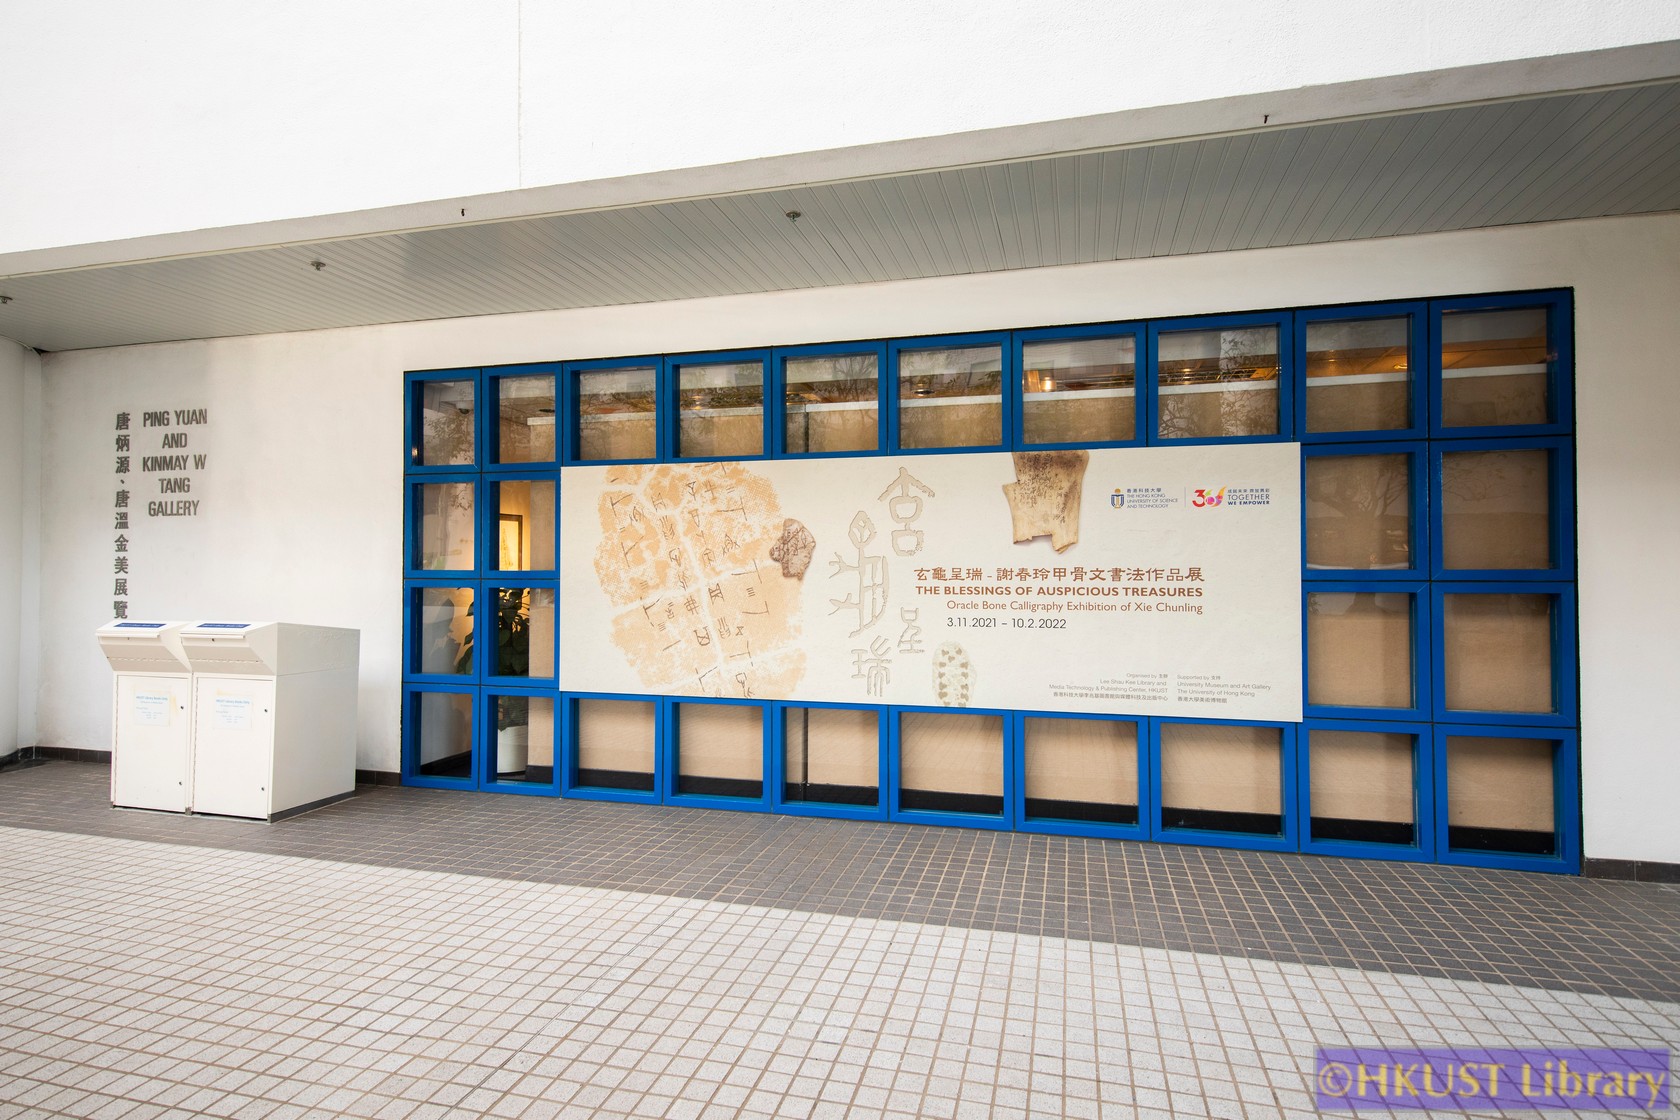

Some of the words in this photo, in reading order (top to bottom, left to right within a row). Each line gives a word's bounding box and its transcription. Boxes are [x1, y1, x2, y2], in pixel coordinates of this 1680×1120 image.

[143, 410, 170, 427] PING
[174, 408, 208, 426] YUAN
[162, 433, 188, 449] AND
[142, 454, 189, 472] KINMAY
[193, 454, 207, 470] W
[158, 477, 190, 494] TANG
[148, 500, 200, 517] GALLERY
[996, 567, 1205, 582] 謝春玲甲骨文書法作品展
[915, 586, 940, 595] THE
[944, 586, 1011, 596] BLESSINGS
[1015, 586, 1033, 596] OF
[1037, 586, 1119, 597] AUSPICIOUS
[1122, 587, 1203, 597] TREASURES
[947, 601, 978, 610] Oracle
[982, 601, 1007, 610] Bone
[1010, 601, 1063, 613] Calligraphy
[1067, 601, 1117, 612] Exhibition
[1120, 602, 1131, 612] of
[1134, 602, 1152, 612] Xie
[1156, 603, 1203, 615] Chunling
[947, 617, 997, 628] 3.11.2021
[1011, 618, 1067, 629] 10.2.2022
